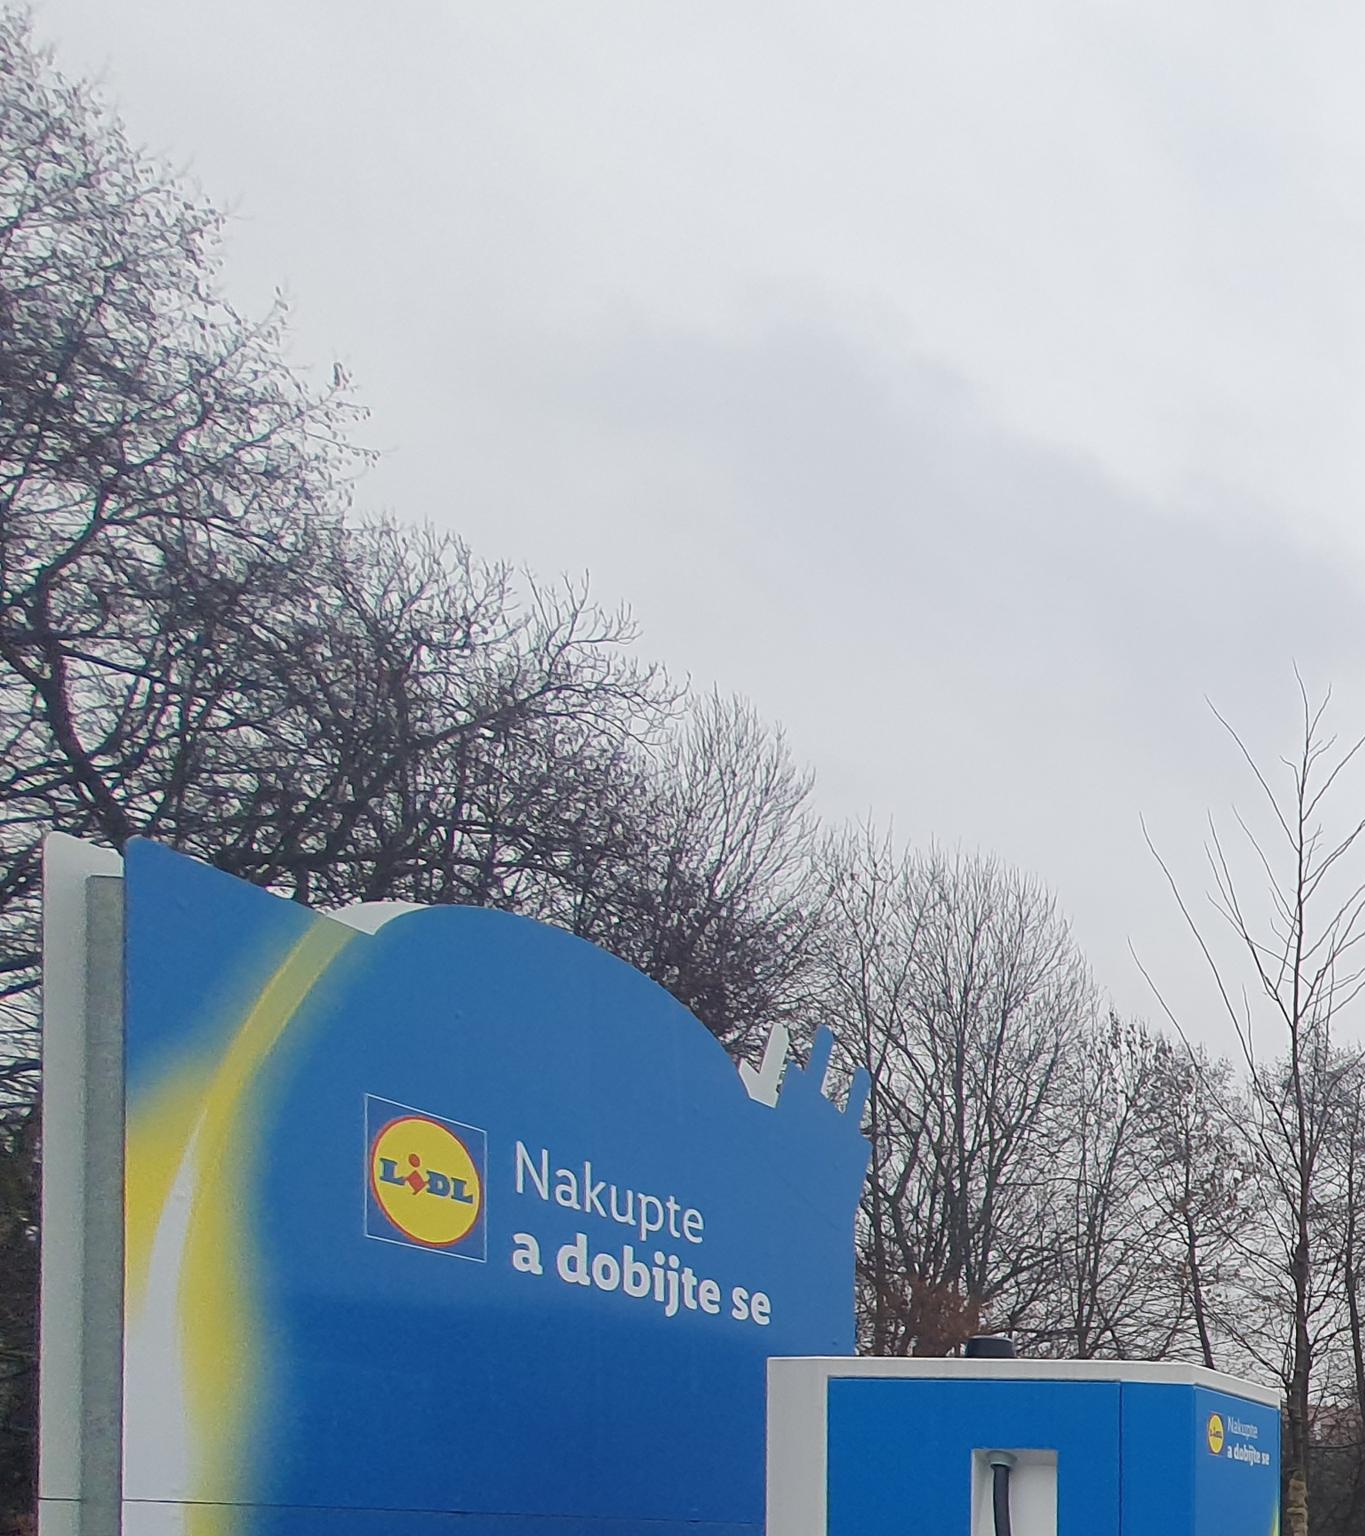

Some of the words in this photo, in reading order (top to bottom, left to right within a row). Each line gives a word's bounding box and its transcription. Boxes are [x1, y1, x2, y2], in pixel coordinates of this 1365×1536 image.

[379, 1154, 474, 1205] LIDL
[515, 1140, 704, 1243] Nakupte
[513, 1233, 543, 1276] a
[556, 1232, 721, 1317] dobijte
[731, 1285, 771, 1325] se
